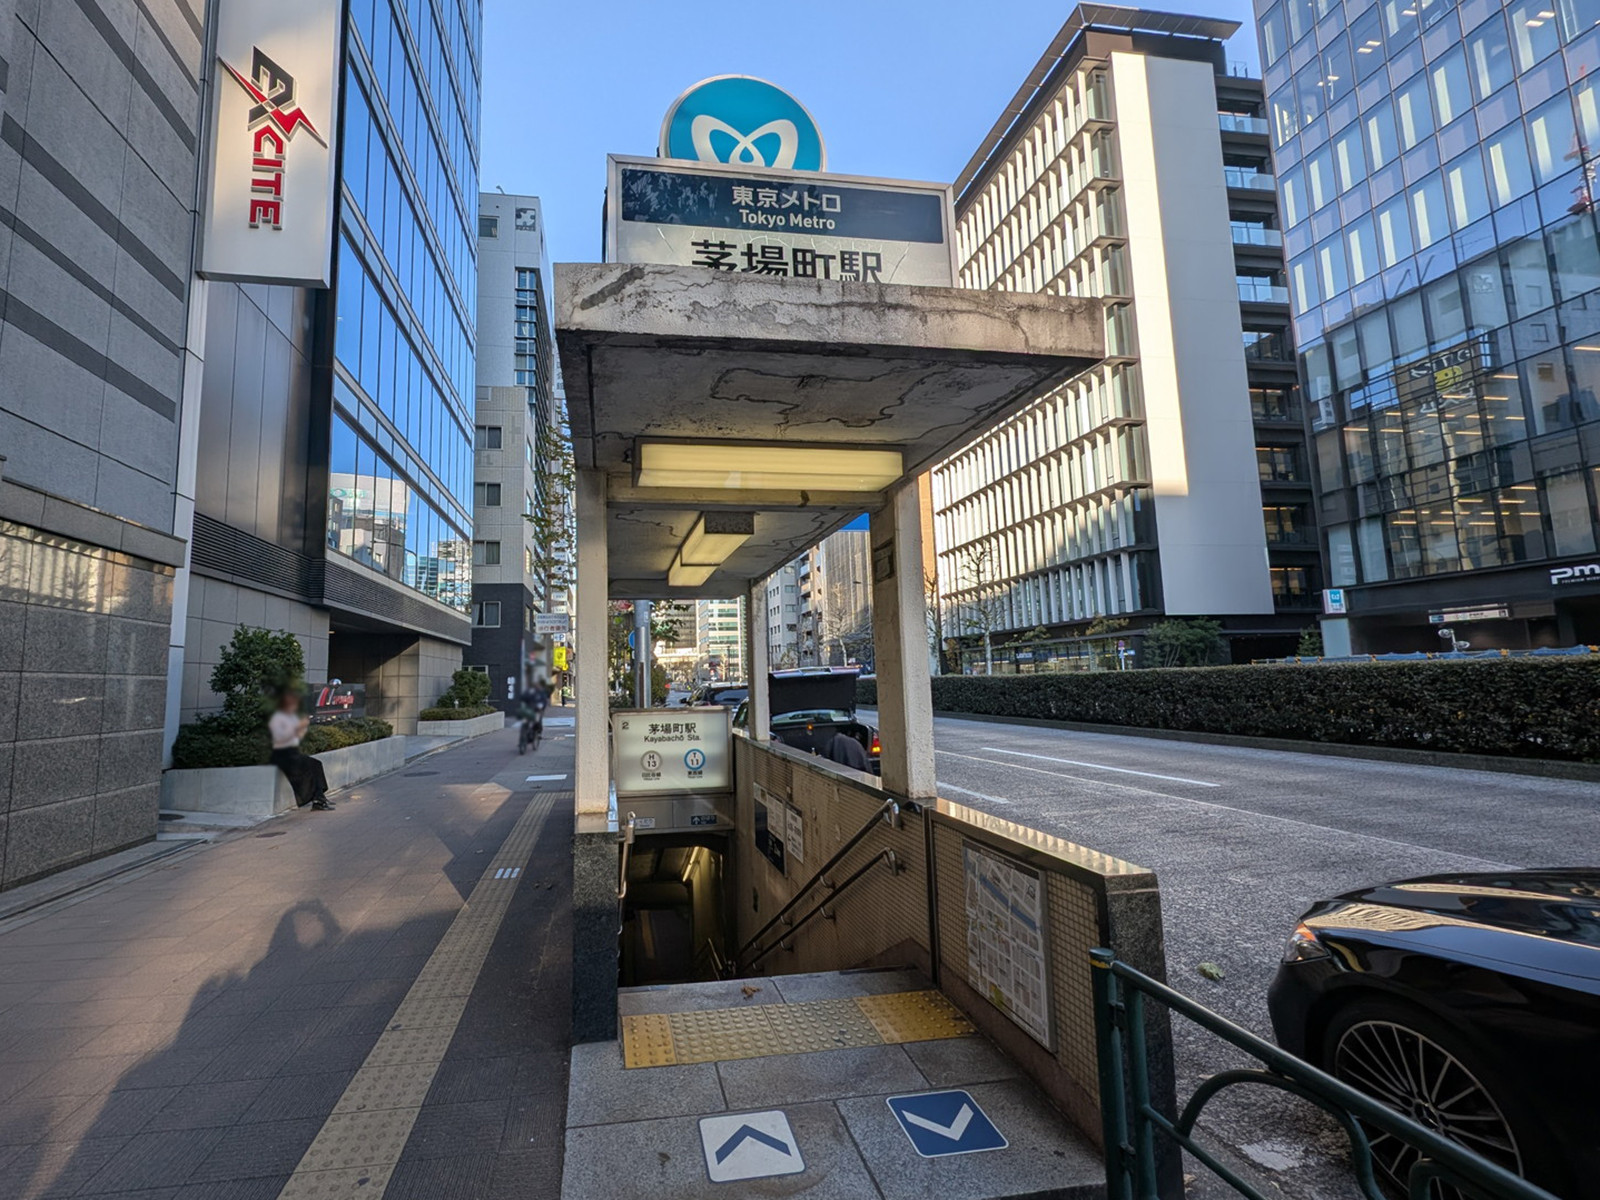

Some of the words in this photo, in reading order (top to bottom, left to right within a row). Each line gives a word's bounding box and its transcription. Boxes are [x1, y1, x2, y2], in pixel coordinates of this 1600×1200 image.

[731, 186, 841, 213] 東京メトロ
[739, 209, 786, 228] Tokyo
[789, 212, 836, 230] Metro
[621, 721, 630, 730] 2
[648, 722, 697, 734] 茅場町駅
